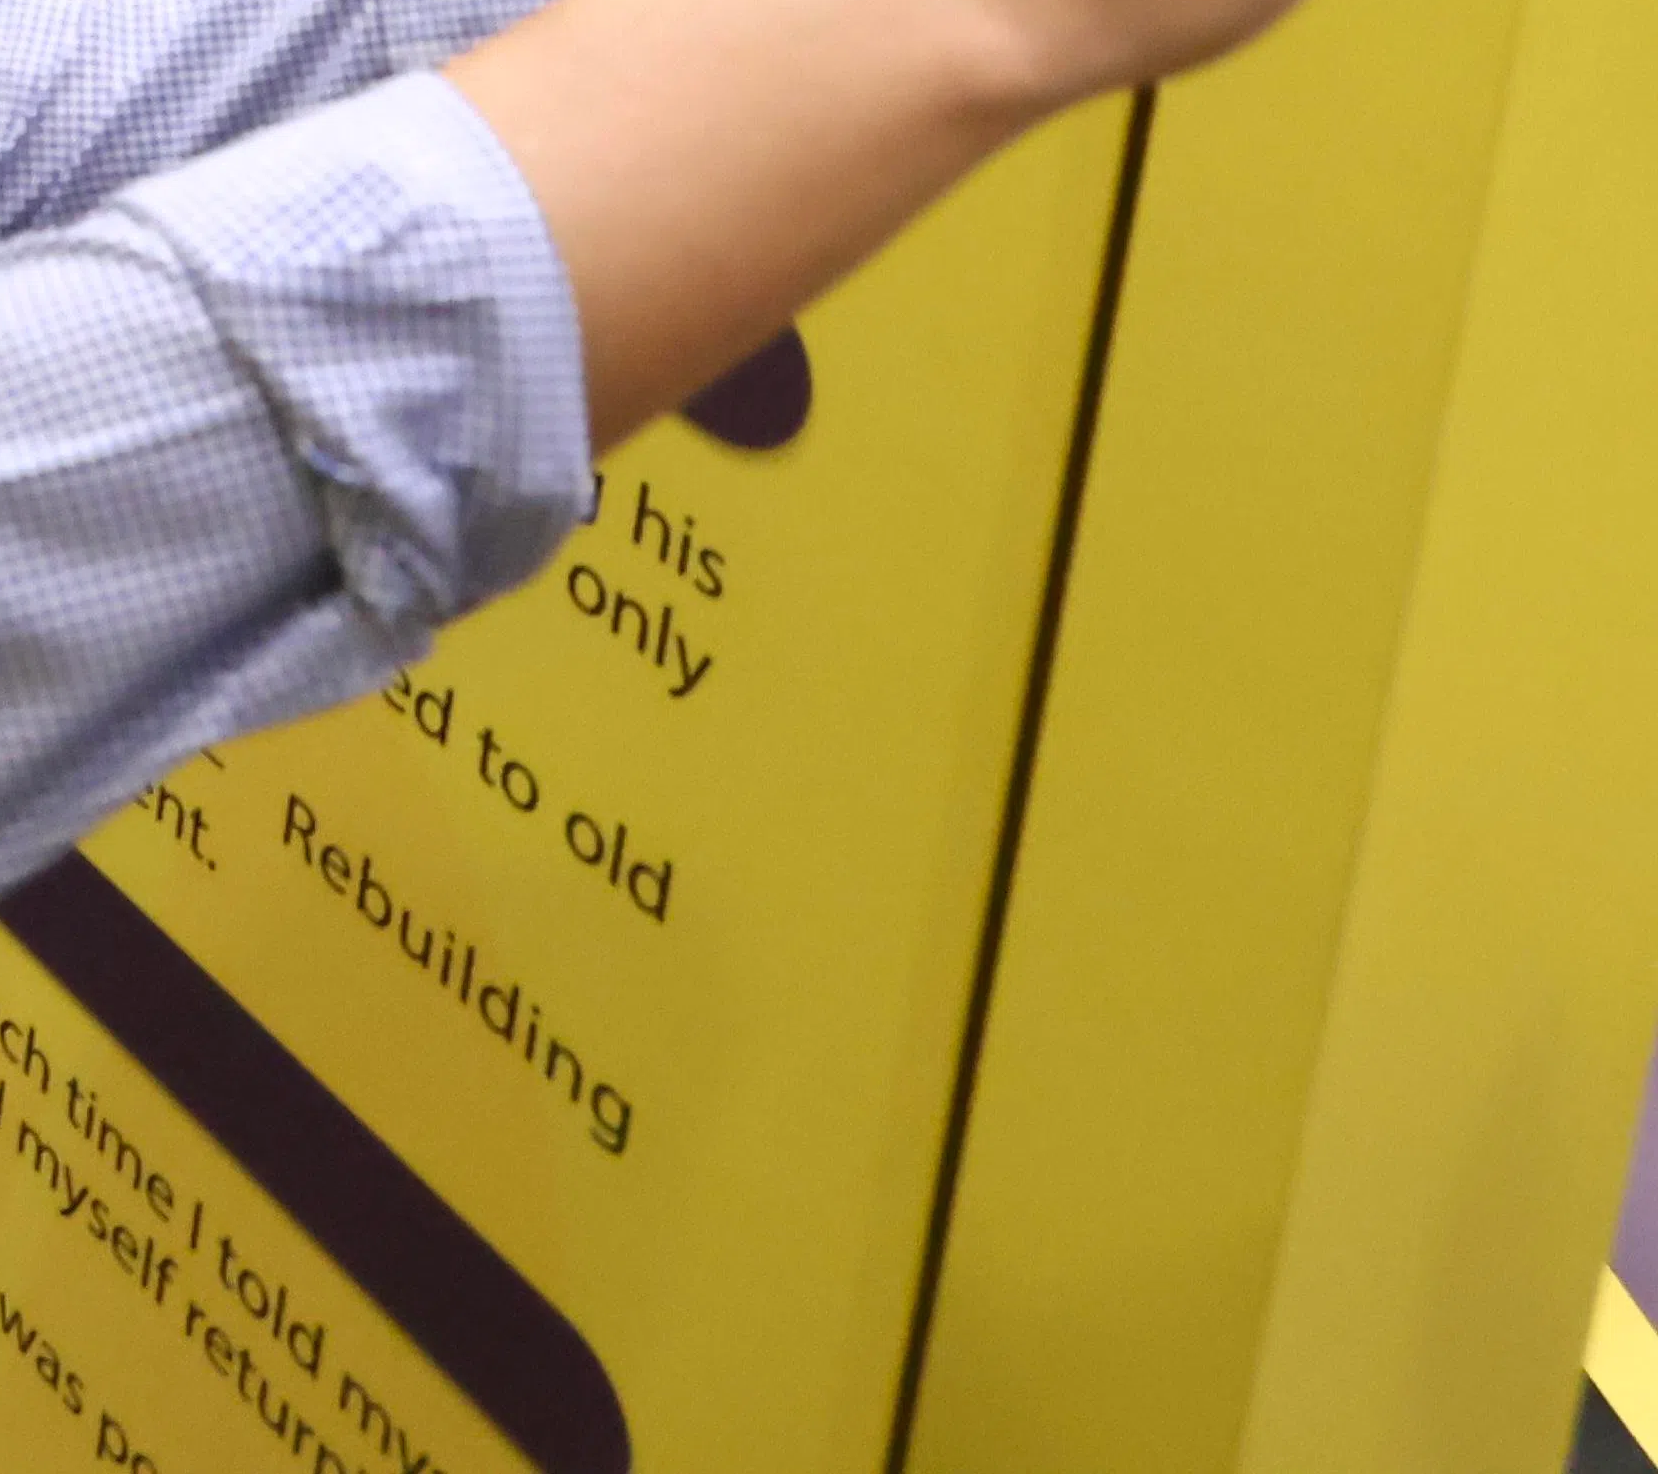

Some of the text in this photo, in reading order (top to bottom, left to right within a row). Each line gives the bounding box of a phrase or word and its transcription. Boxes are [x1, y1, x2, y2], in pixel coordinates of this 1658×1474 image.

[567, 564, 714, 699] only
[632, 482, 727, 600] his
[478, 725, 540, 813] to
[565, 810, 674, 926] old
[281, 792, 635, 1157] Rebuilding
[18, 1119, 179, 1309] myself
[66, 1076, 175, 1223] time
[189, 1199, 205, 1252] I
[219, 1235, 326, 1380] told
[0, 1291, 85, 1417] was
